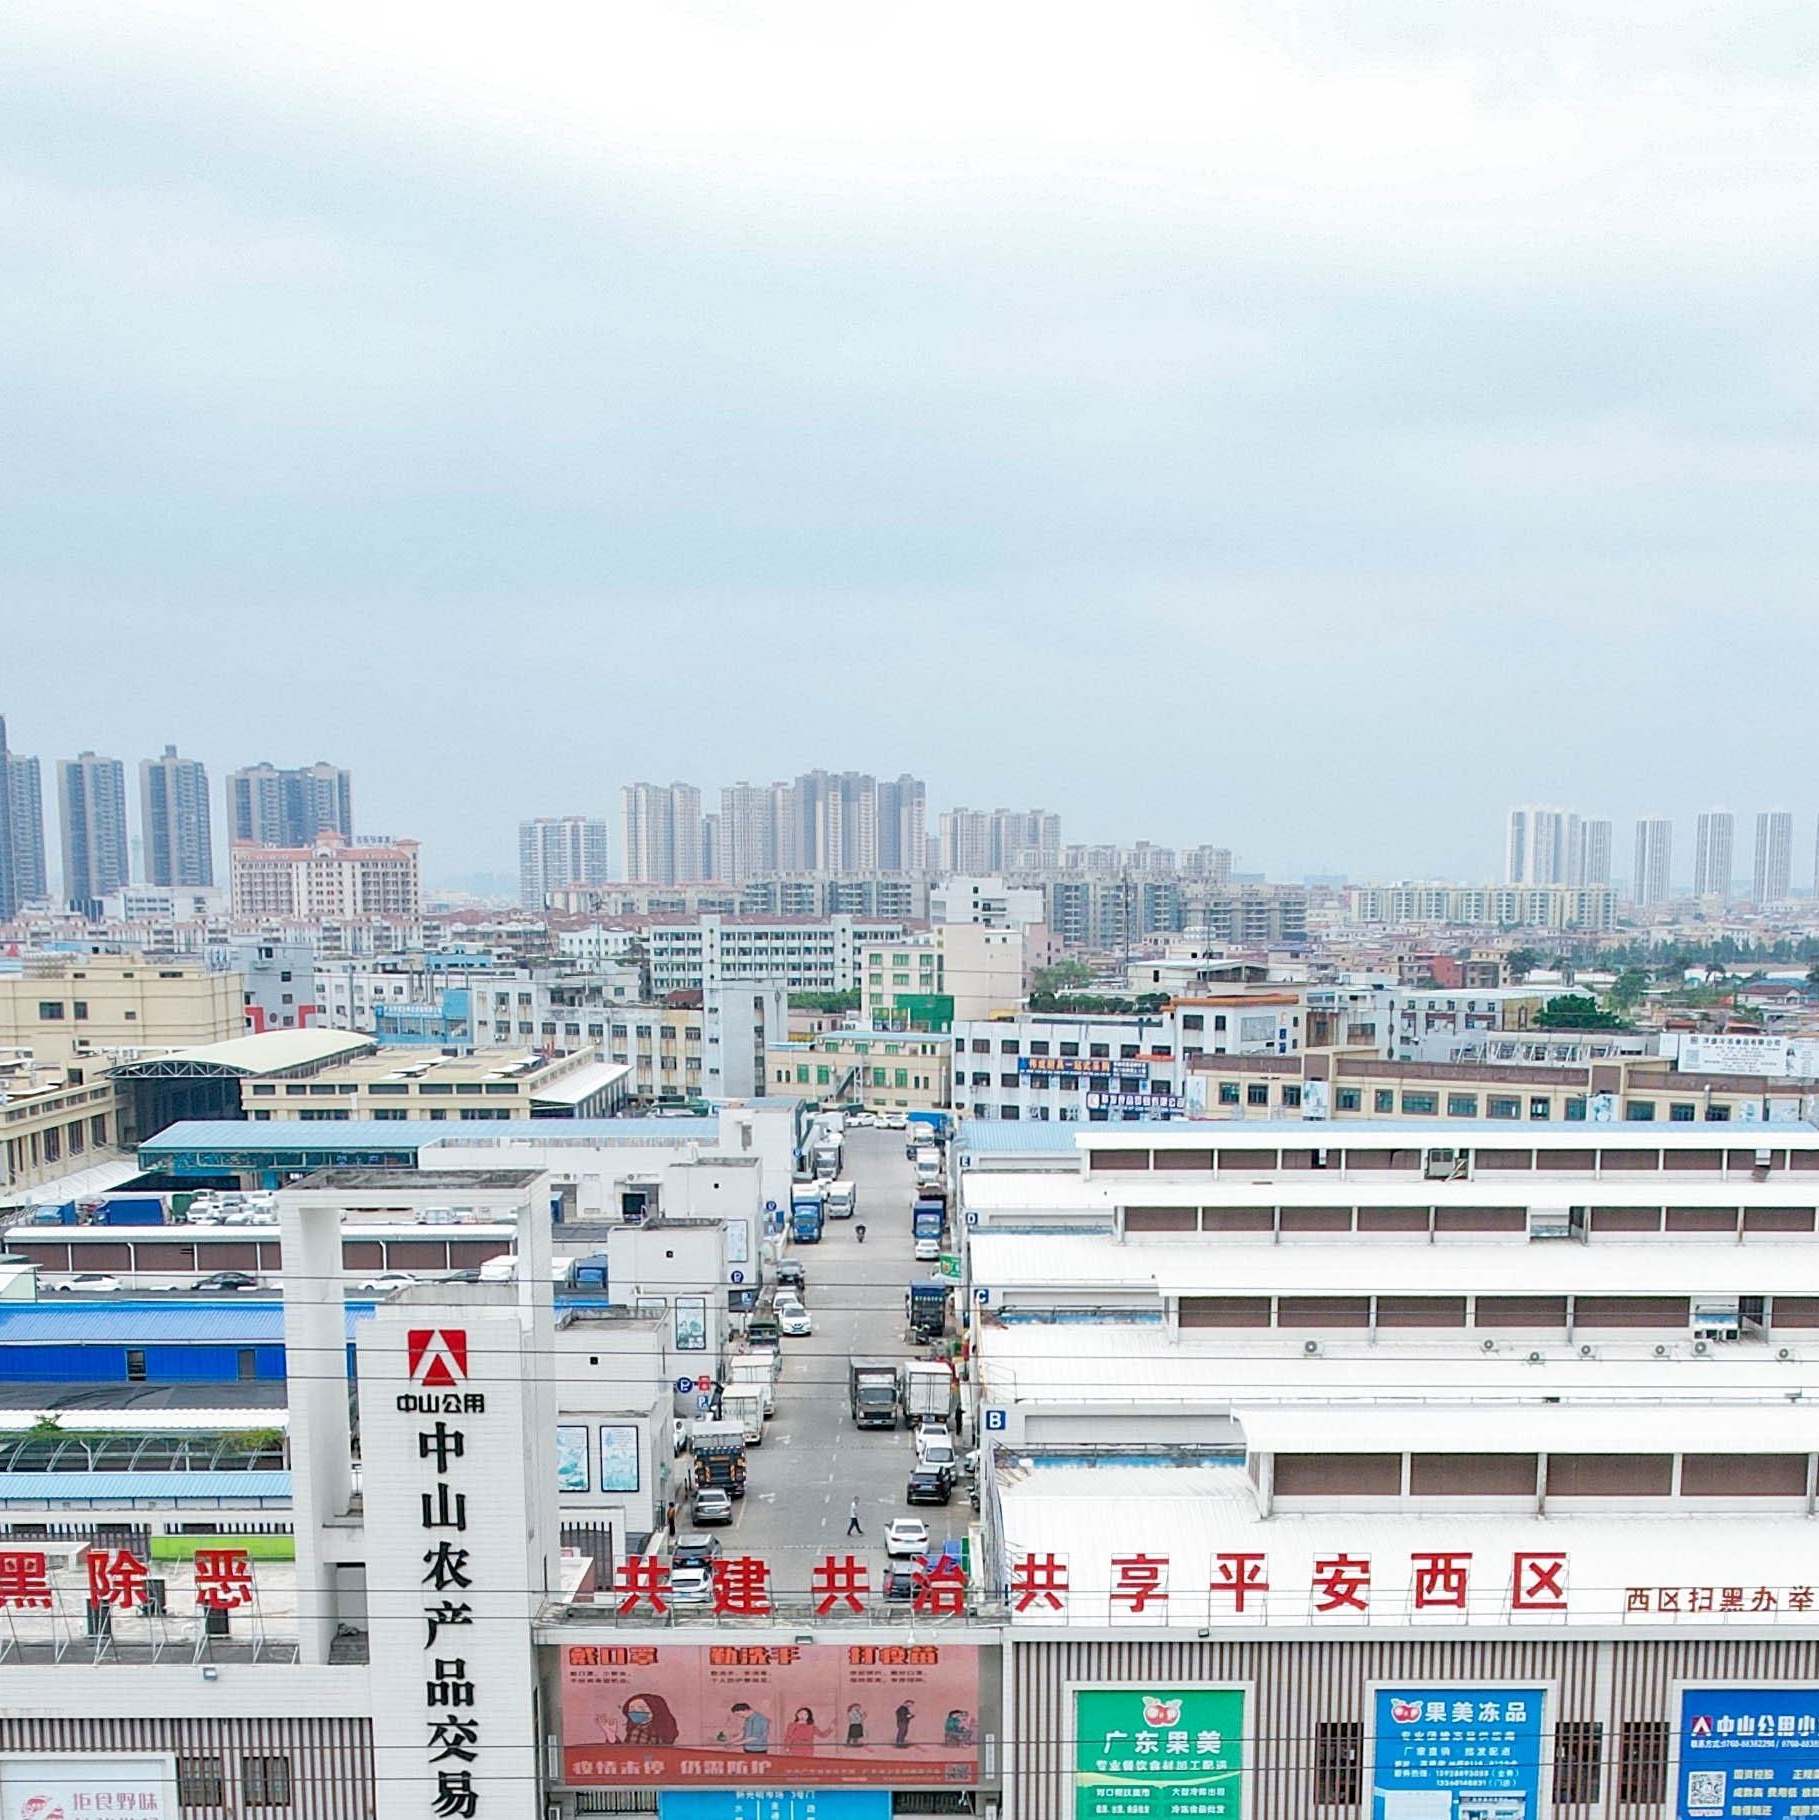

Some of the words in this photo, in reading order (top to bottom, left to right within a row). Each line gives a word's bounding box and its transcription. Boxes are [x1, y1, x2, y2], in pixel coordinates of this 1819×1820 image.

[397, 1393, 485, 1414] 中山公用
[988, 1412, 1002, 1428] B
[615, 1551, 1569, 1616] 共建共治共享平安西区
[569, 1646, 658, 1666] 戴口罩
[710, 1646, 801, 1666] 勤洗手
[849, 1646, 939, 1666] 打疫苗
[1425, 1701, 1527, 1723] 果美冻品
[1103, 1730, 1222, 1754] 广东果美
[573, 1760, 665, 1776] 疫情未停
[73, 1792, 158, 1811] 拒食野味
